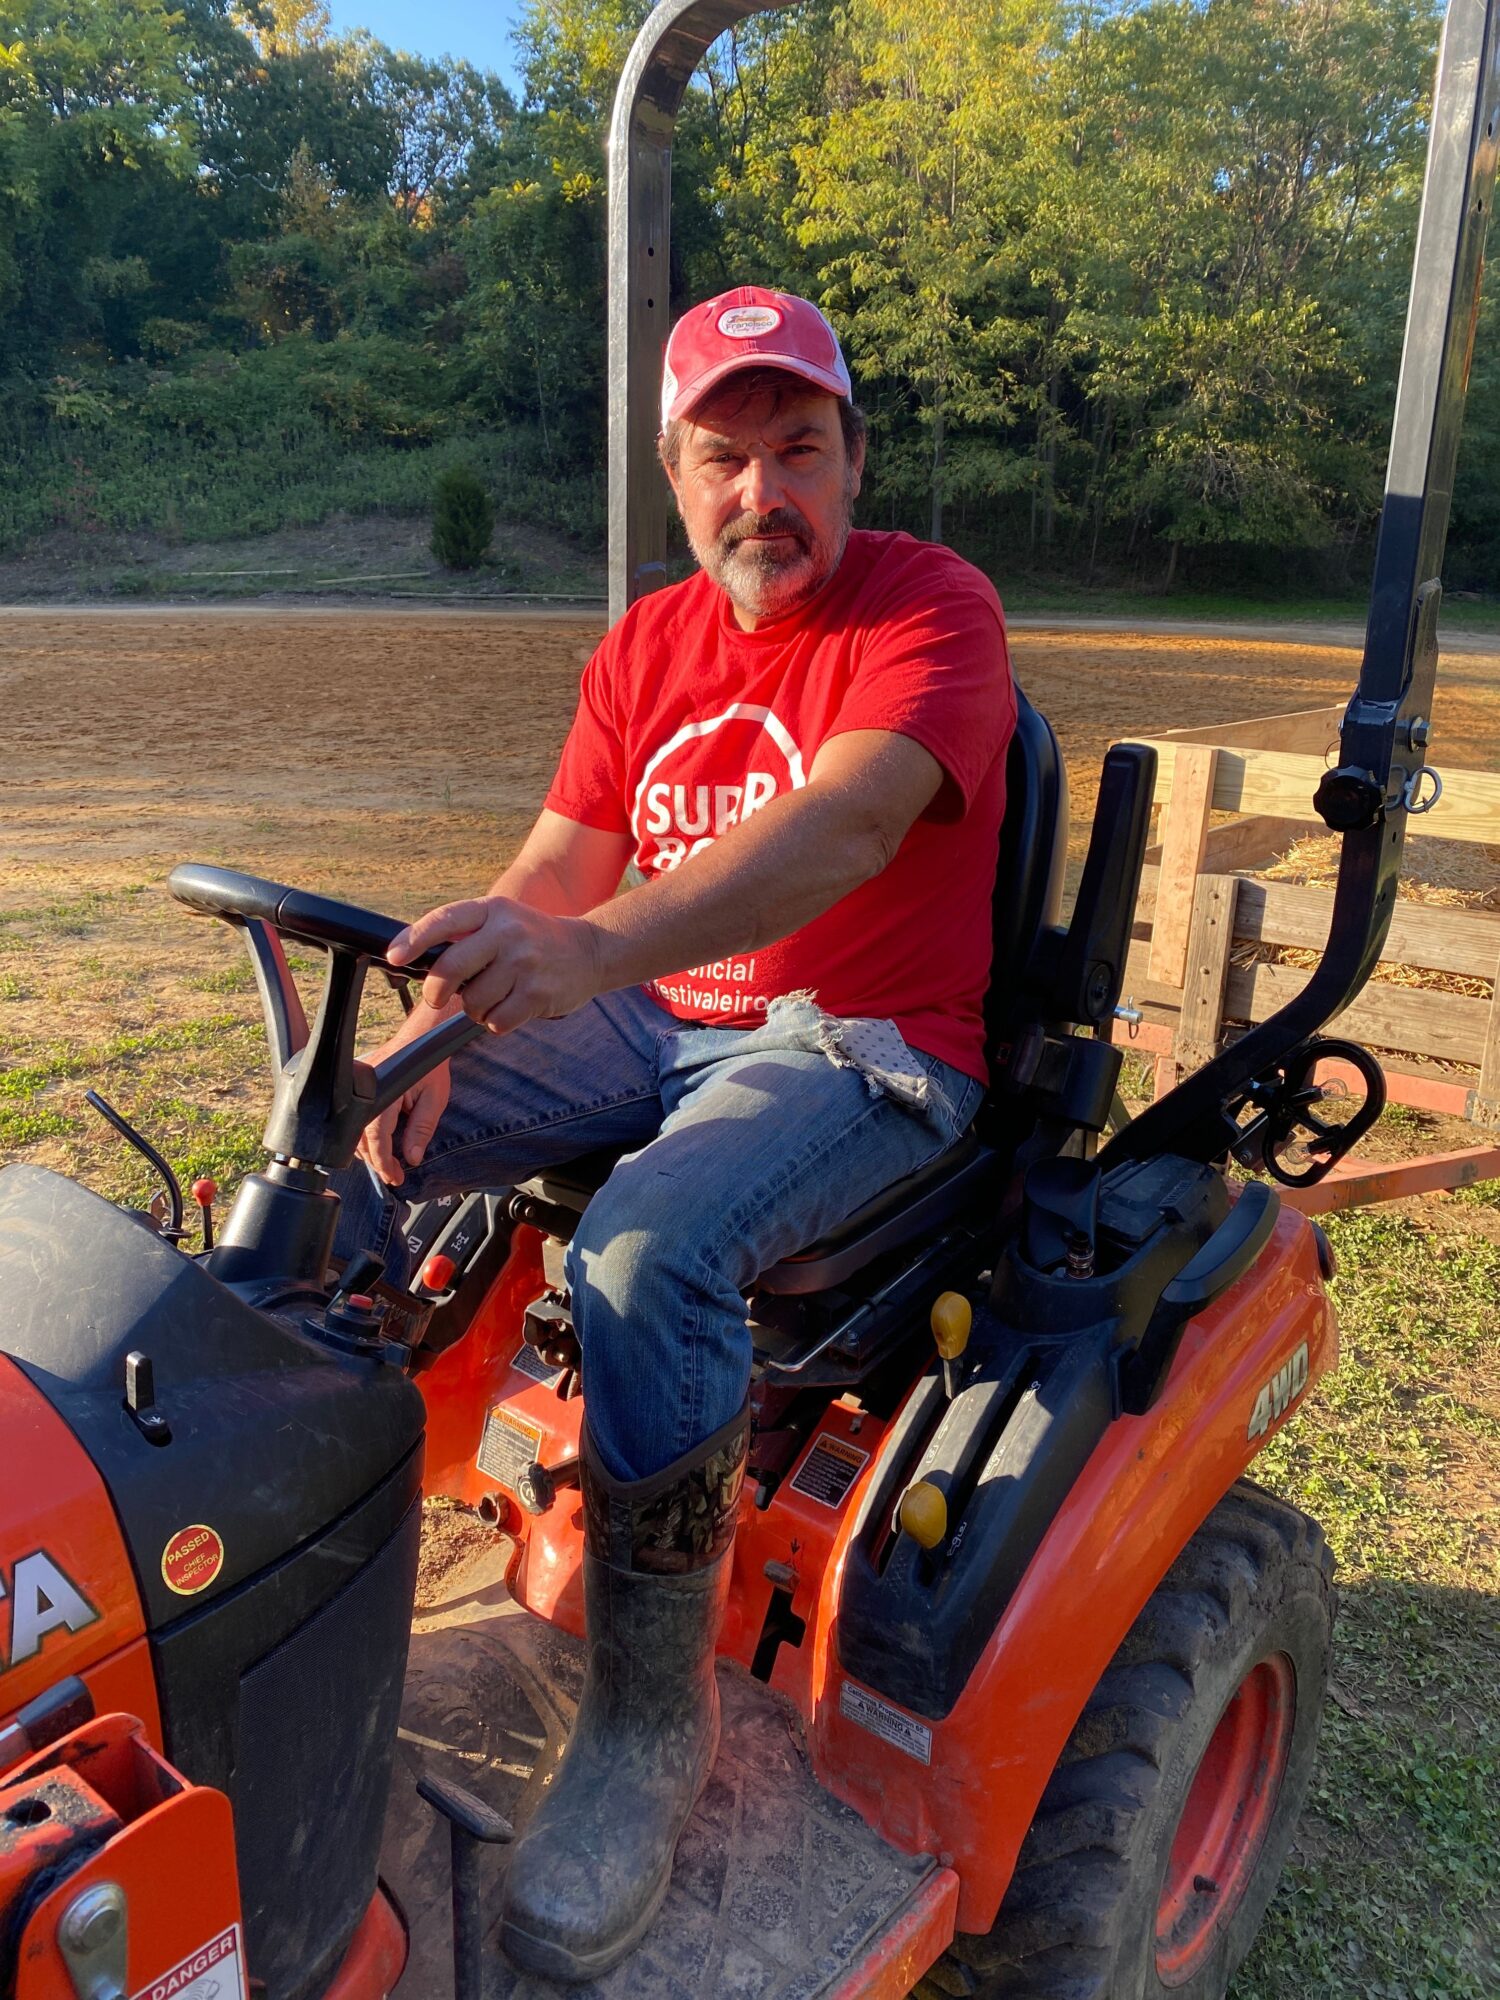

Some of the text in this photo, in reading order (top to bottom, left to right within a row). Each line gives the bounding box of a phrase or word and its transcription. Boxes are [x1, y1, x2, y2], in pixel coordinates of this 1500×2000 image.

[1247, 1341, 1308, 1441] 4WD
[829, 1443, 863, 1463] WARNING
[167, 1531, 209, 1565] PASSED
[183, 1553, 205, 1572] CHIEF
[176, 1553, 218, 1587] INSPECTOR
[866, 1705, 903, 1732] WARNING
[151, 1935, 232, 2000] DANGER
